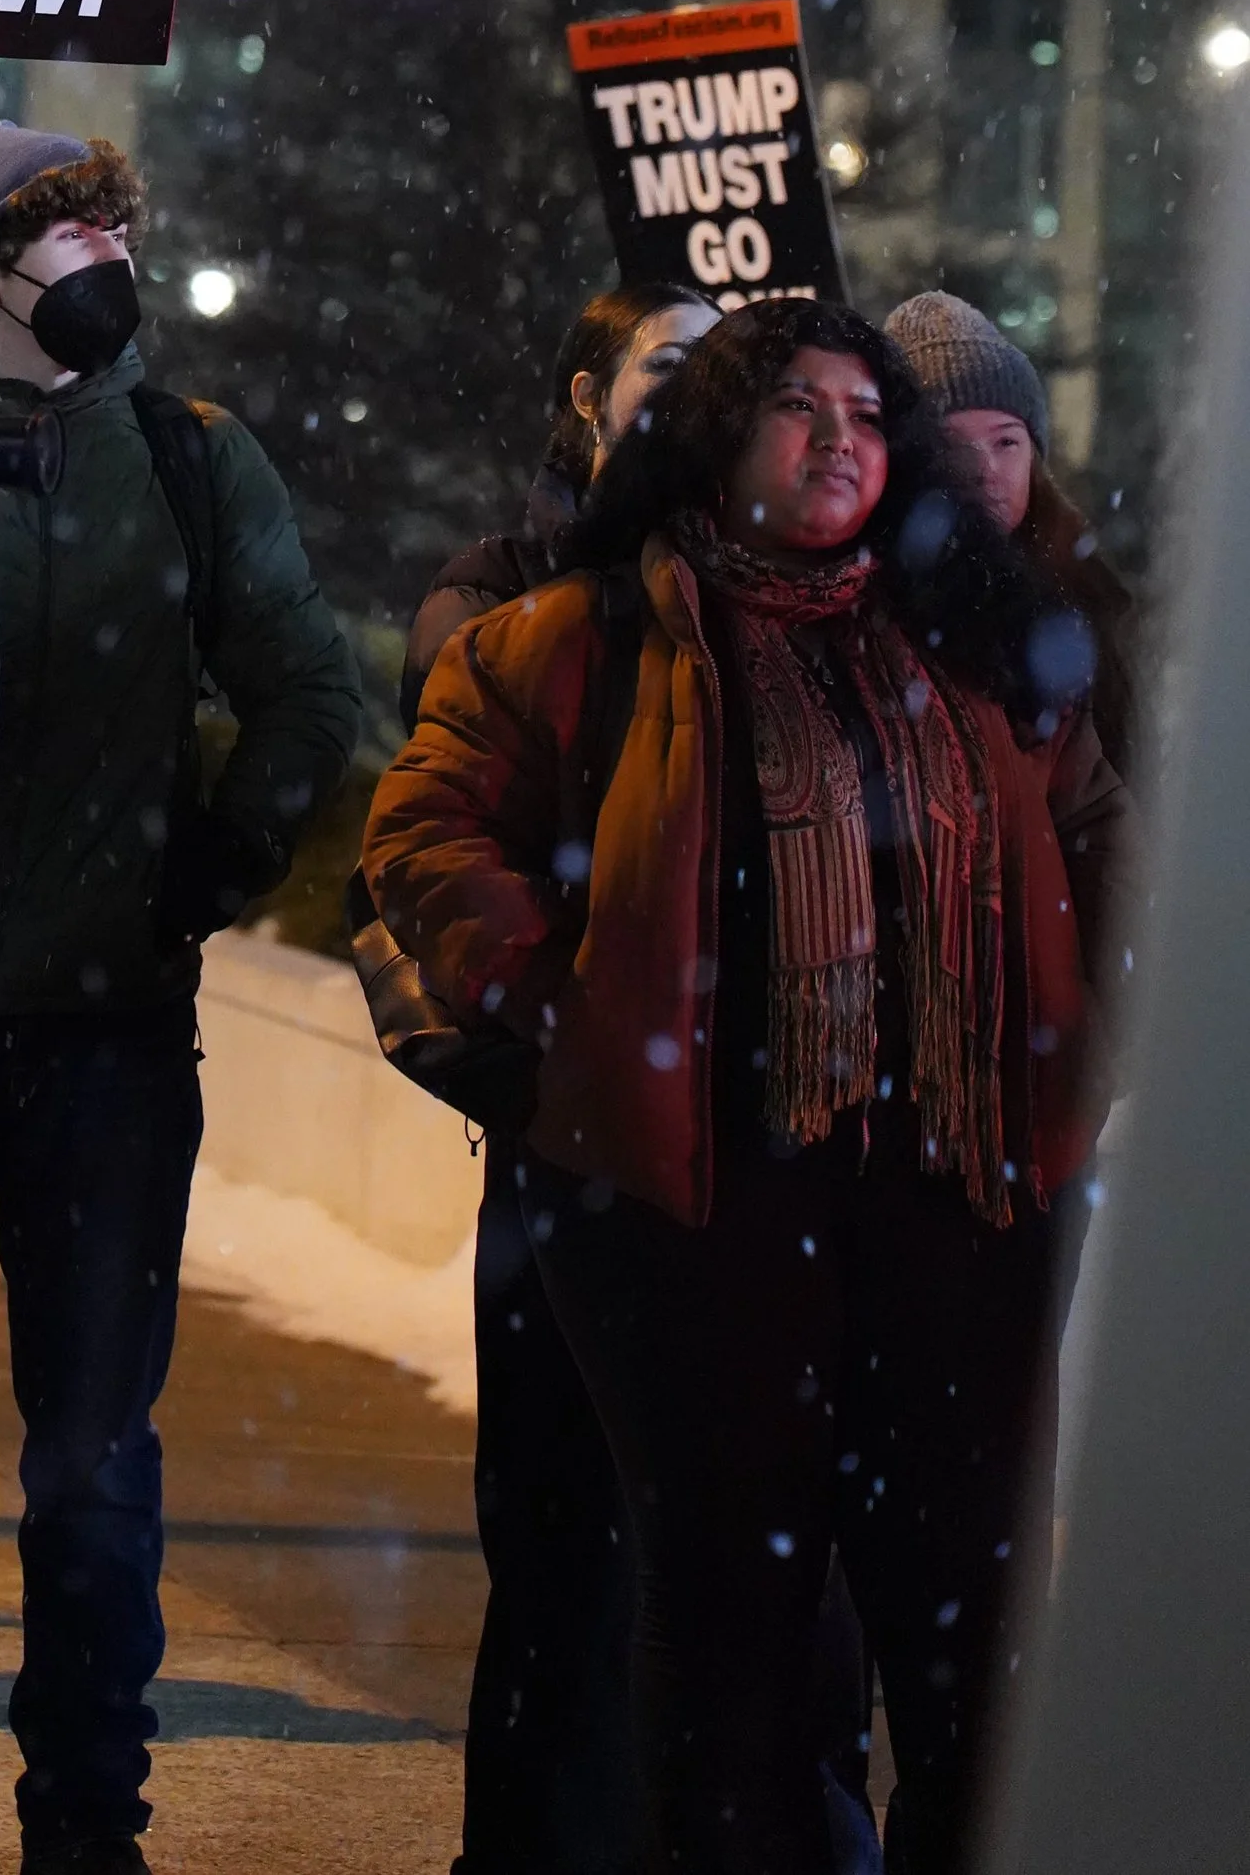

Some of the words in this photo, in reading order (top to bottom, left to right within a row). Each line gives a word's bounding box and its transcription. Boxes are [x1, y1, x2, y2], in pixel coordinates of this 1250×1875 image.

[595, 68, 798, 147] TRUMP
[631, 142, 788, 217] MUST
[688, 218, 771, 285] GO
